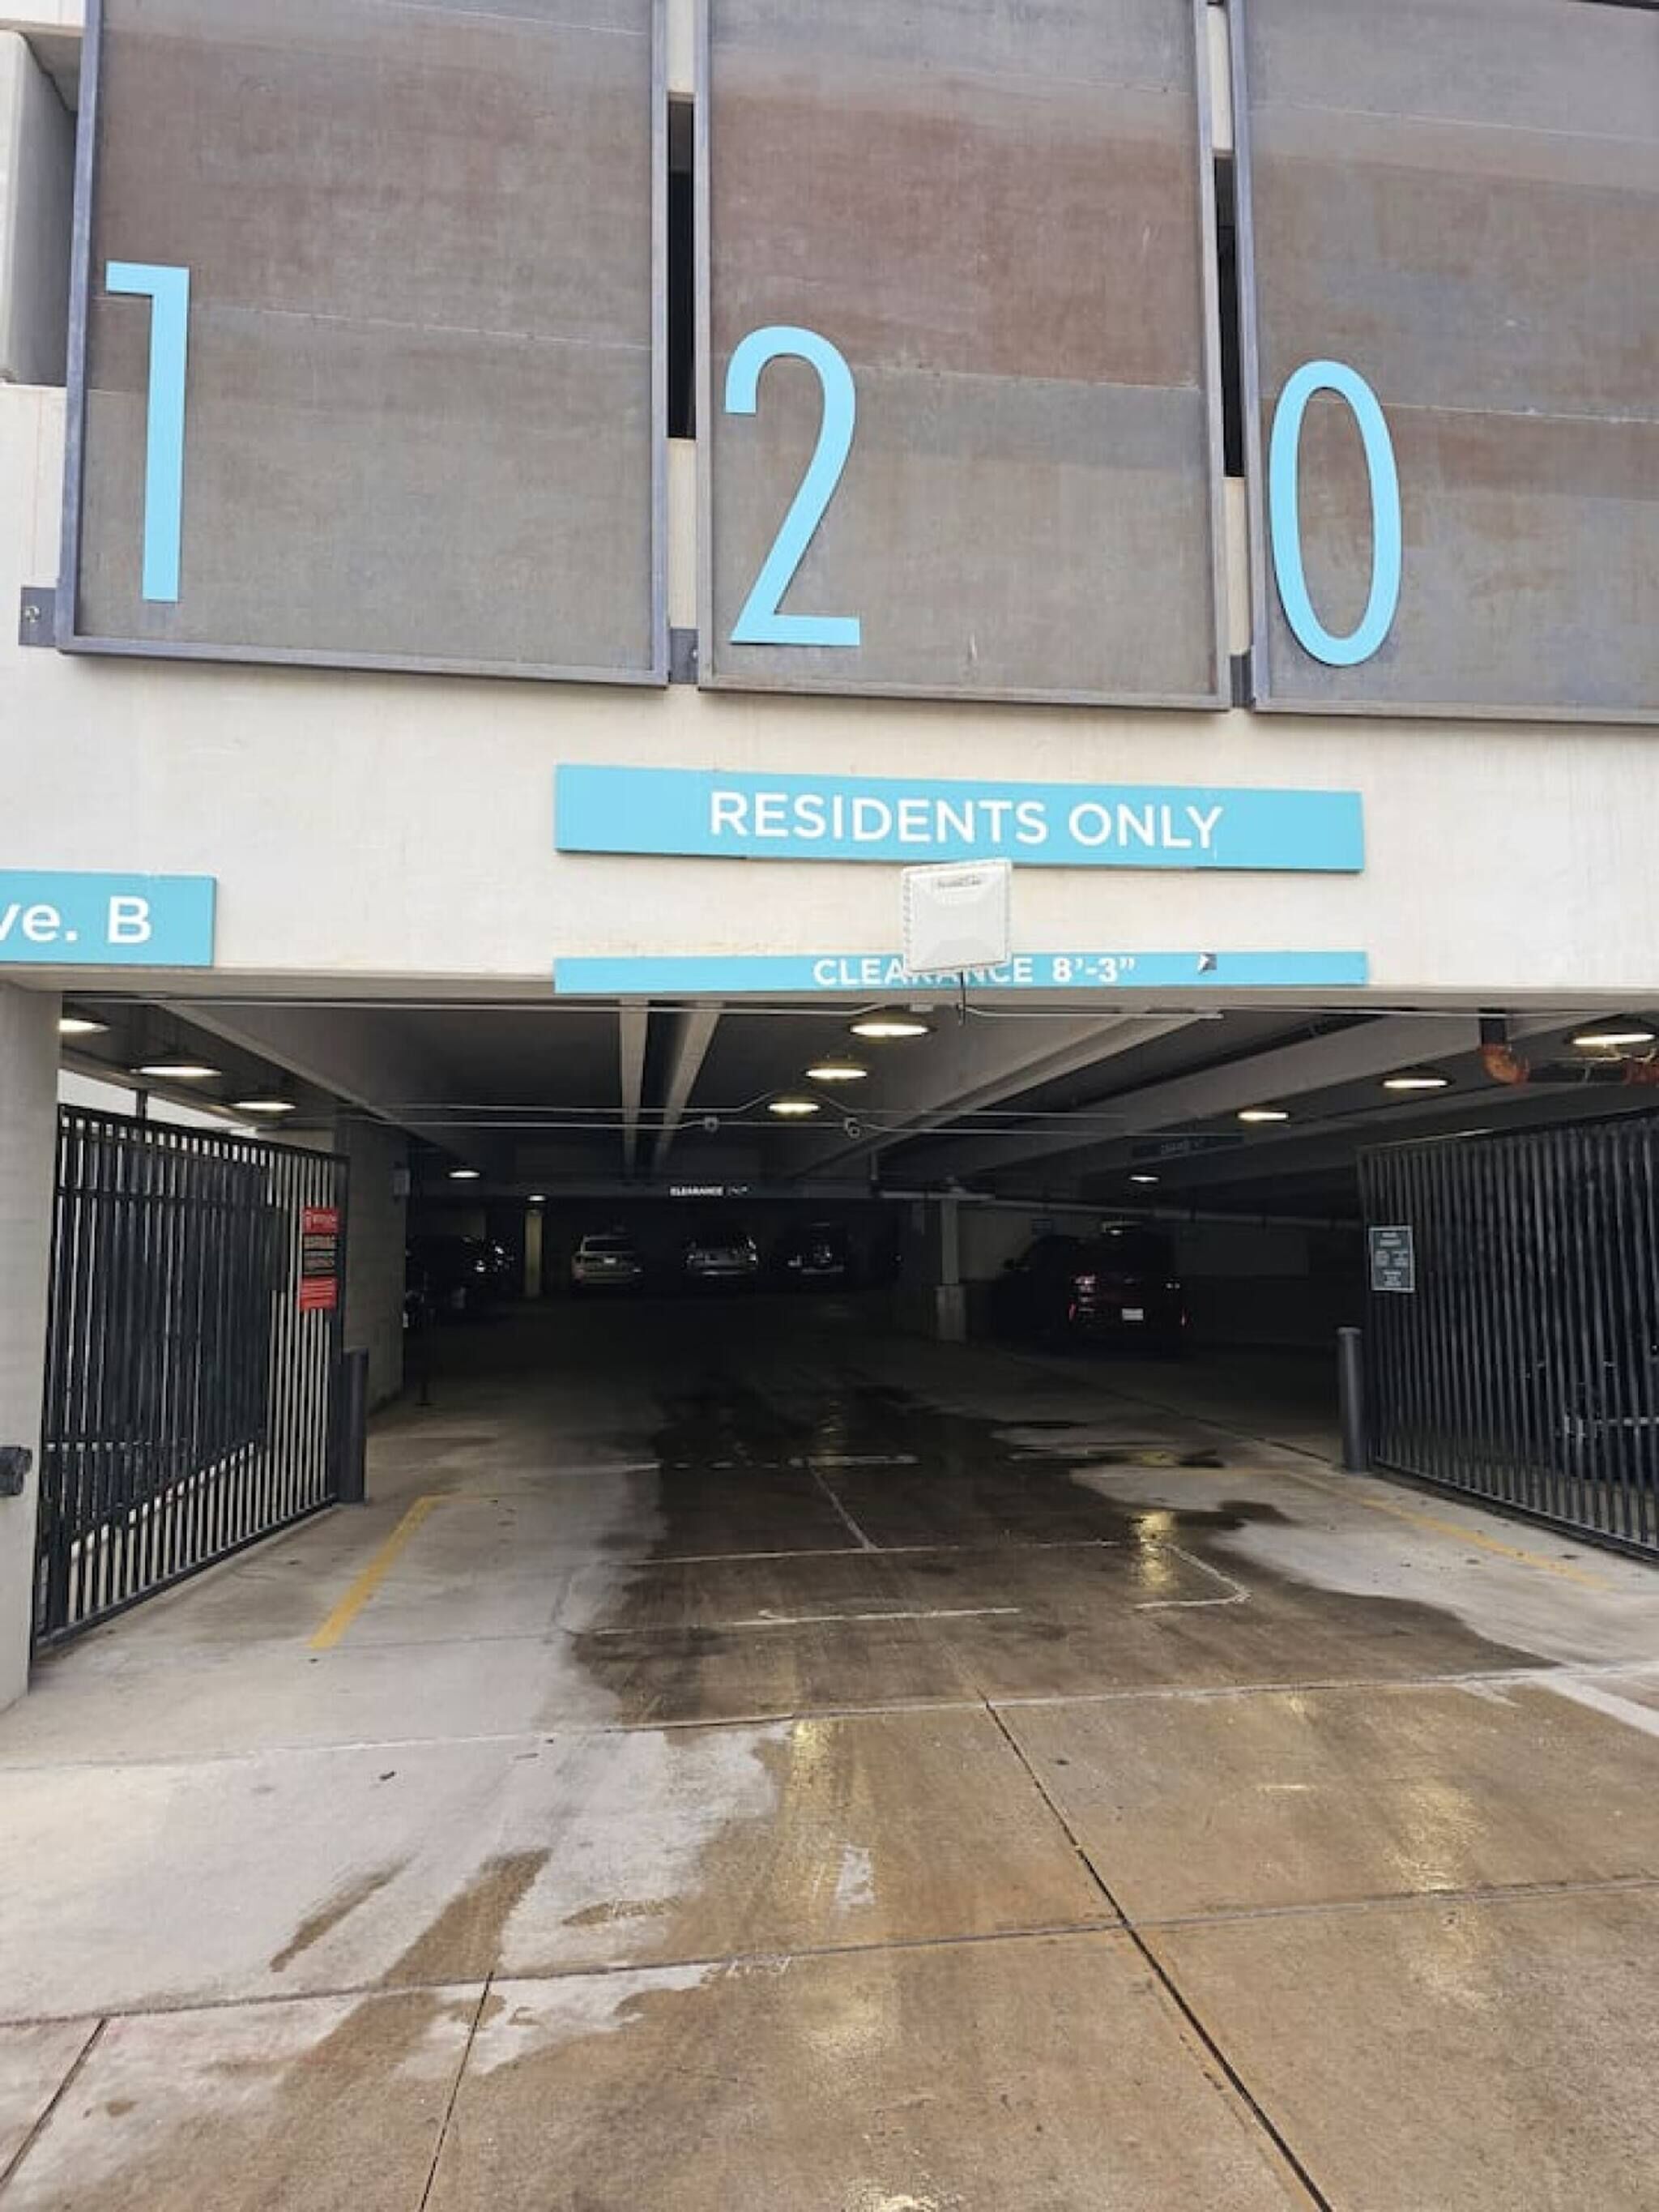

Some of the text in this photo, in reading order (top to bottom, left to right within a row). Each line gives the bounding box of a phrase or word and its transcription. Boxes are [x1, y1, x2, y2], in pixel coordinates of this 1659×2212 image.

[105, 261, 1402, 666] 1 2 0
[710, 790, 1224, 848] RESIDENTS ONLY
[107, 895, 152, 944] B
